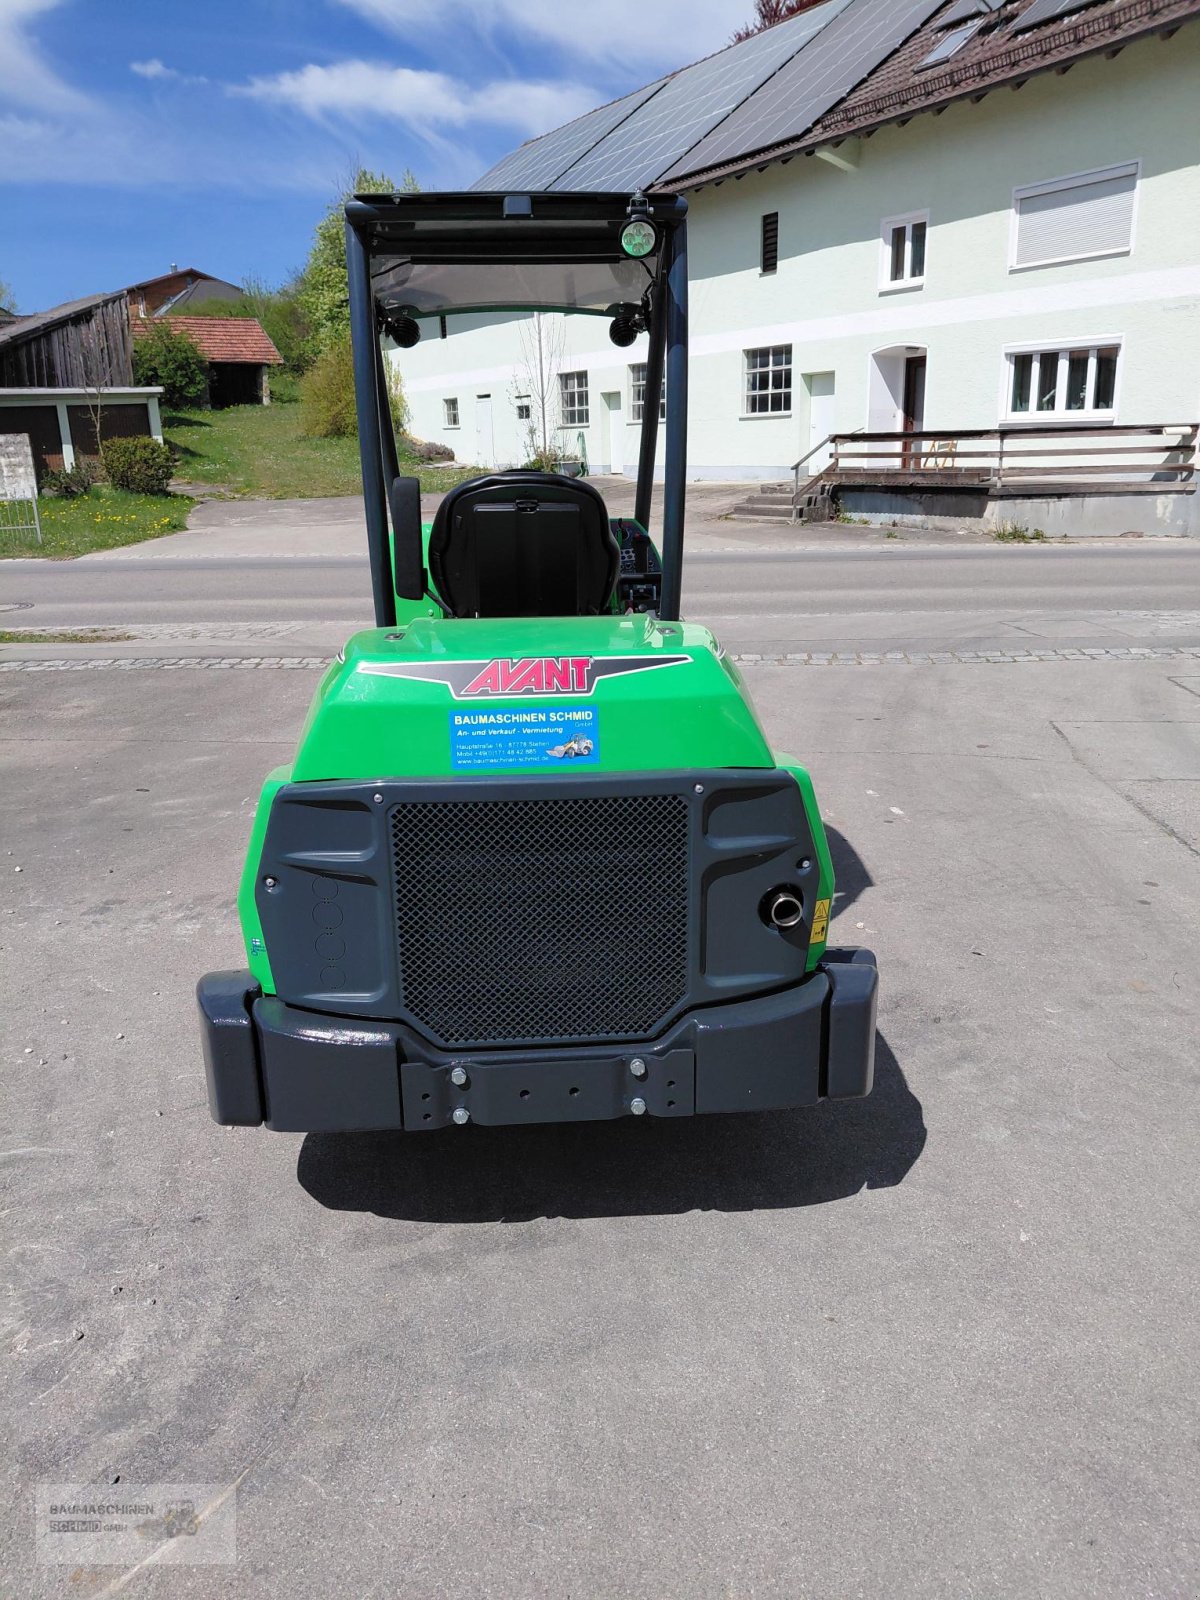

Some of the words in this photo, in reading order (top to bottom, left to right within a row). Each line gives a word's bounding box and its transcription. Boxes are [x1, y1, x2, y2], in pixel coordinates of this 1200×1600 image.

[460, 657, 592, 695] AVANT
[454, 712, 546, 725] BAUMASCHINEN
[550, 710, 593, 722] SCHMID
[457, 729, 470, 737] An-
[472, 728, 486, 736] und
[488, 727, 516, 736] Verkauf
[522, 726, 563, 735] Vermietung
